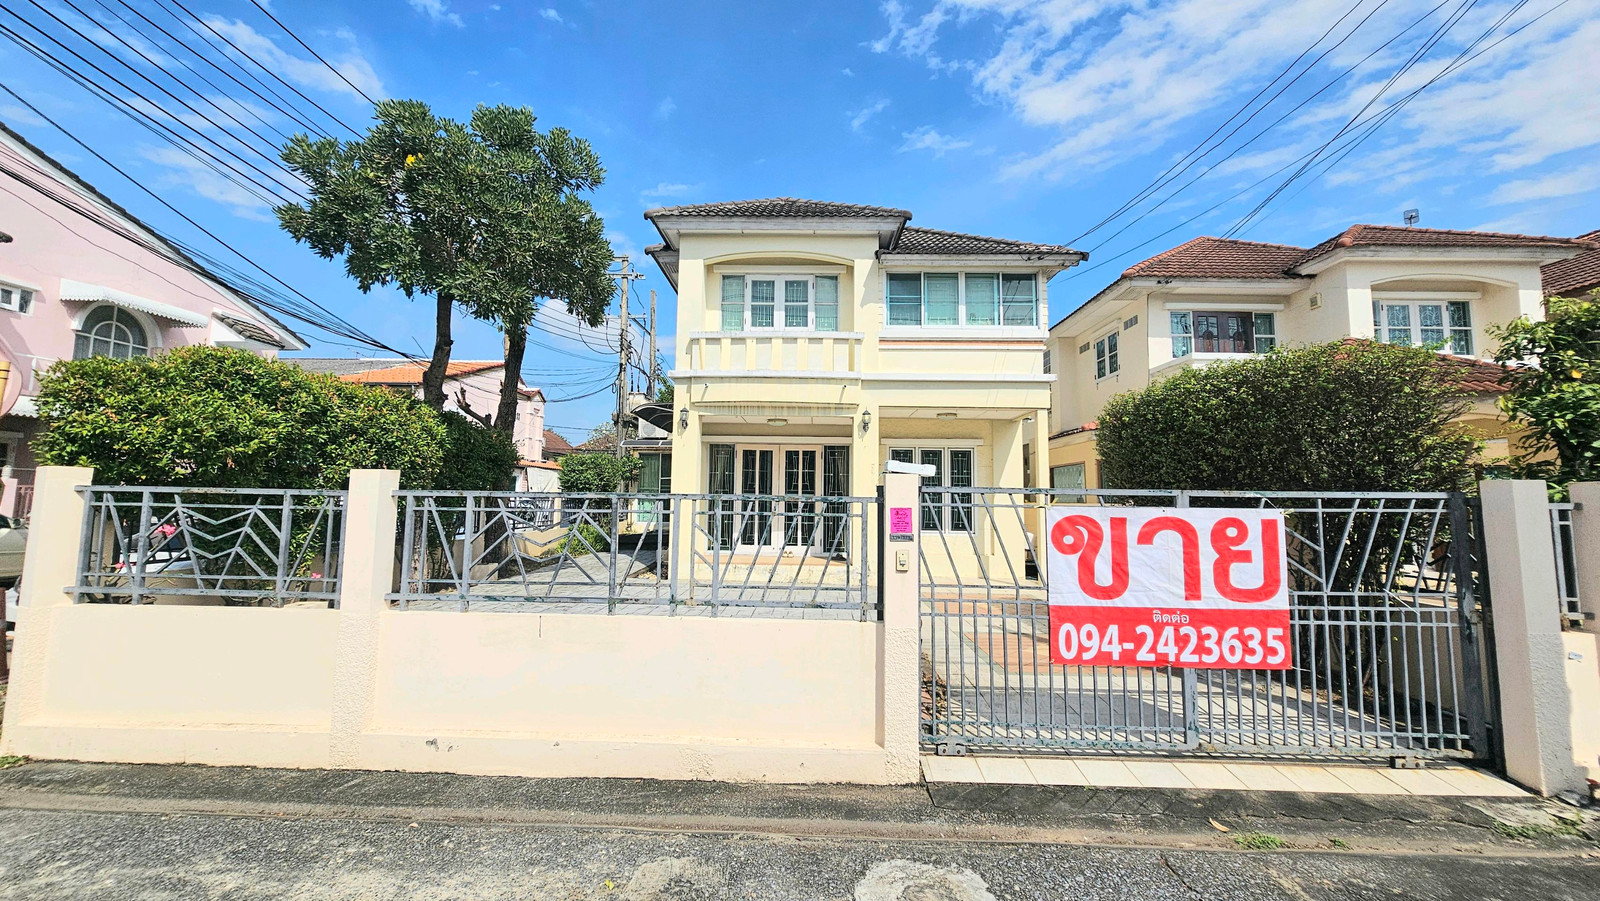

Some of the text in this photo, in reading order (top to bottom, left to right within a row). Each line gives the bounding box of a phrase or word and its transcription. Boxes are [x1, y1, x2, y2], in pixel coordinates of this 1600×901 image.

[1051, 514, 1281, 603] ขาย
[1153, 610, 1189, 623] ติดต่อ
[1058, 623, 1286, 664] 094-2423635
